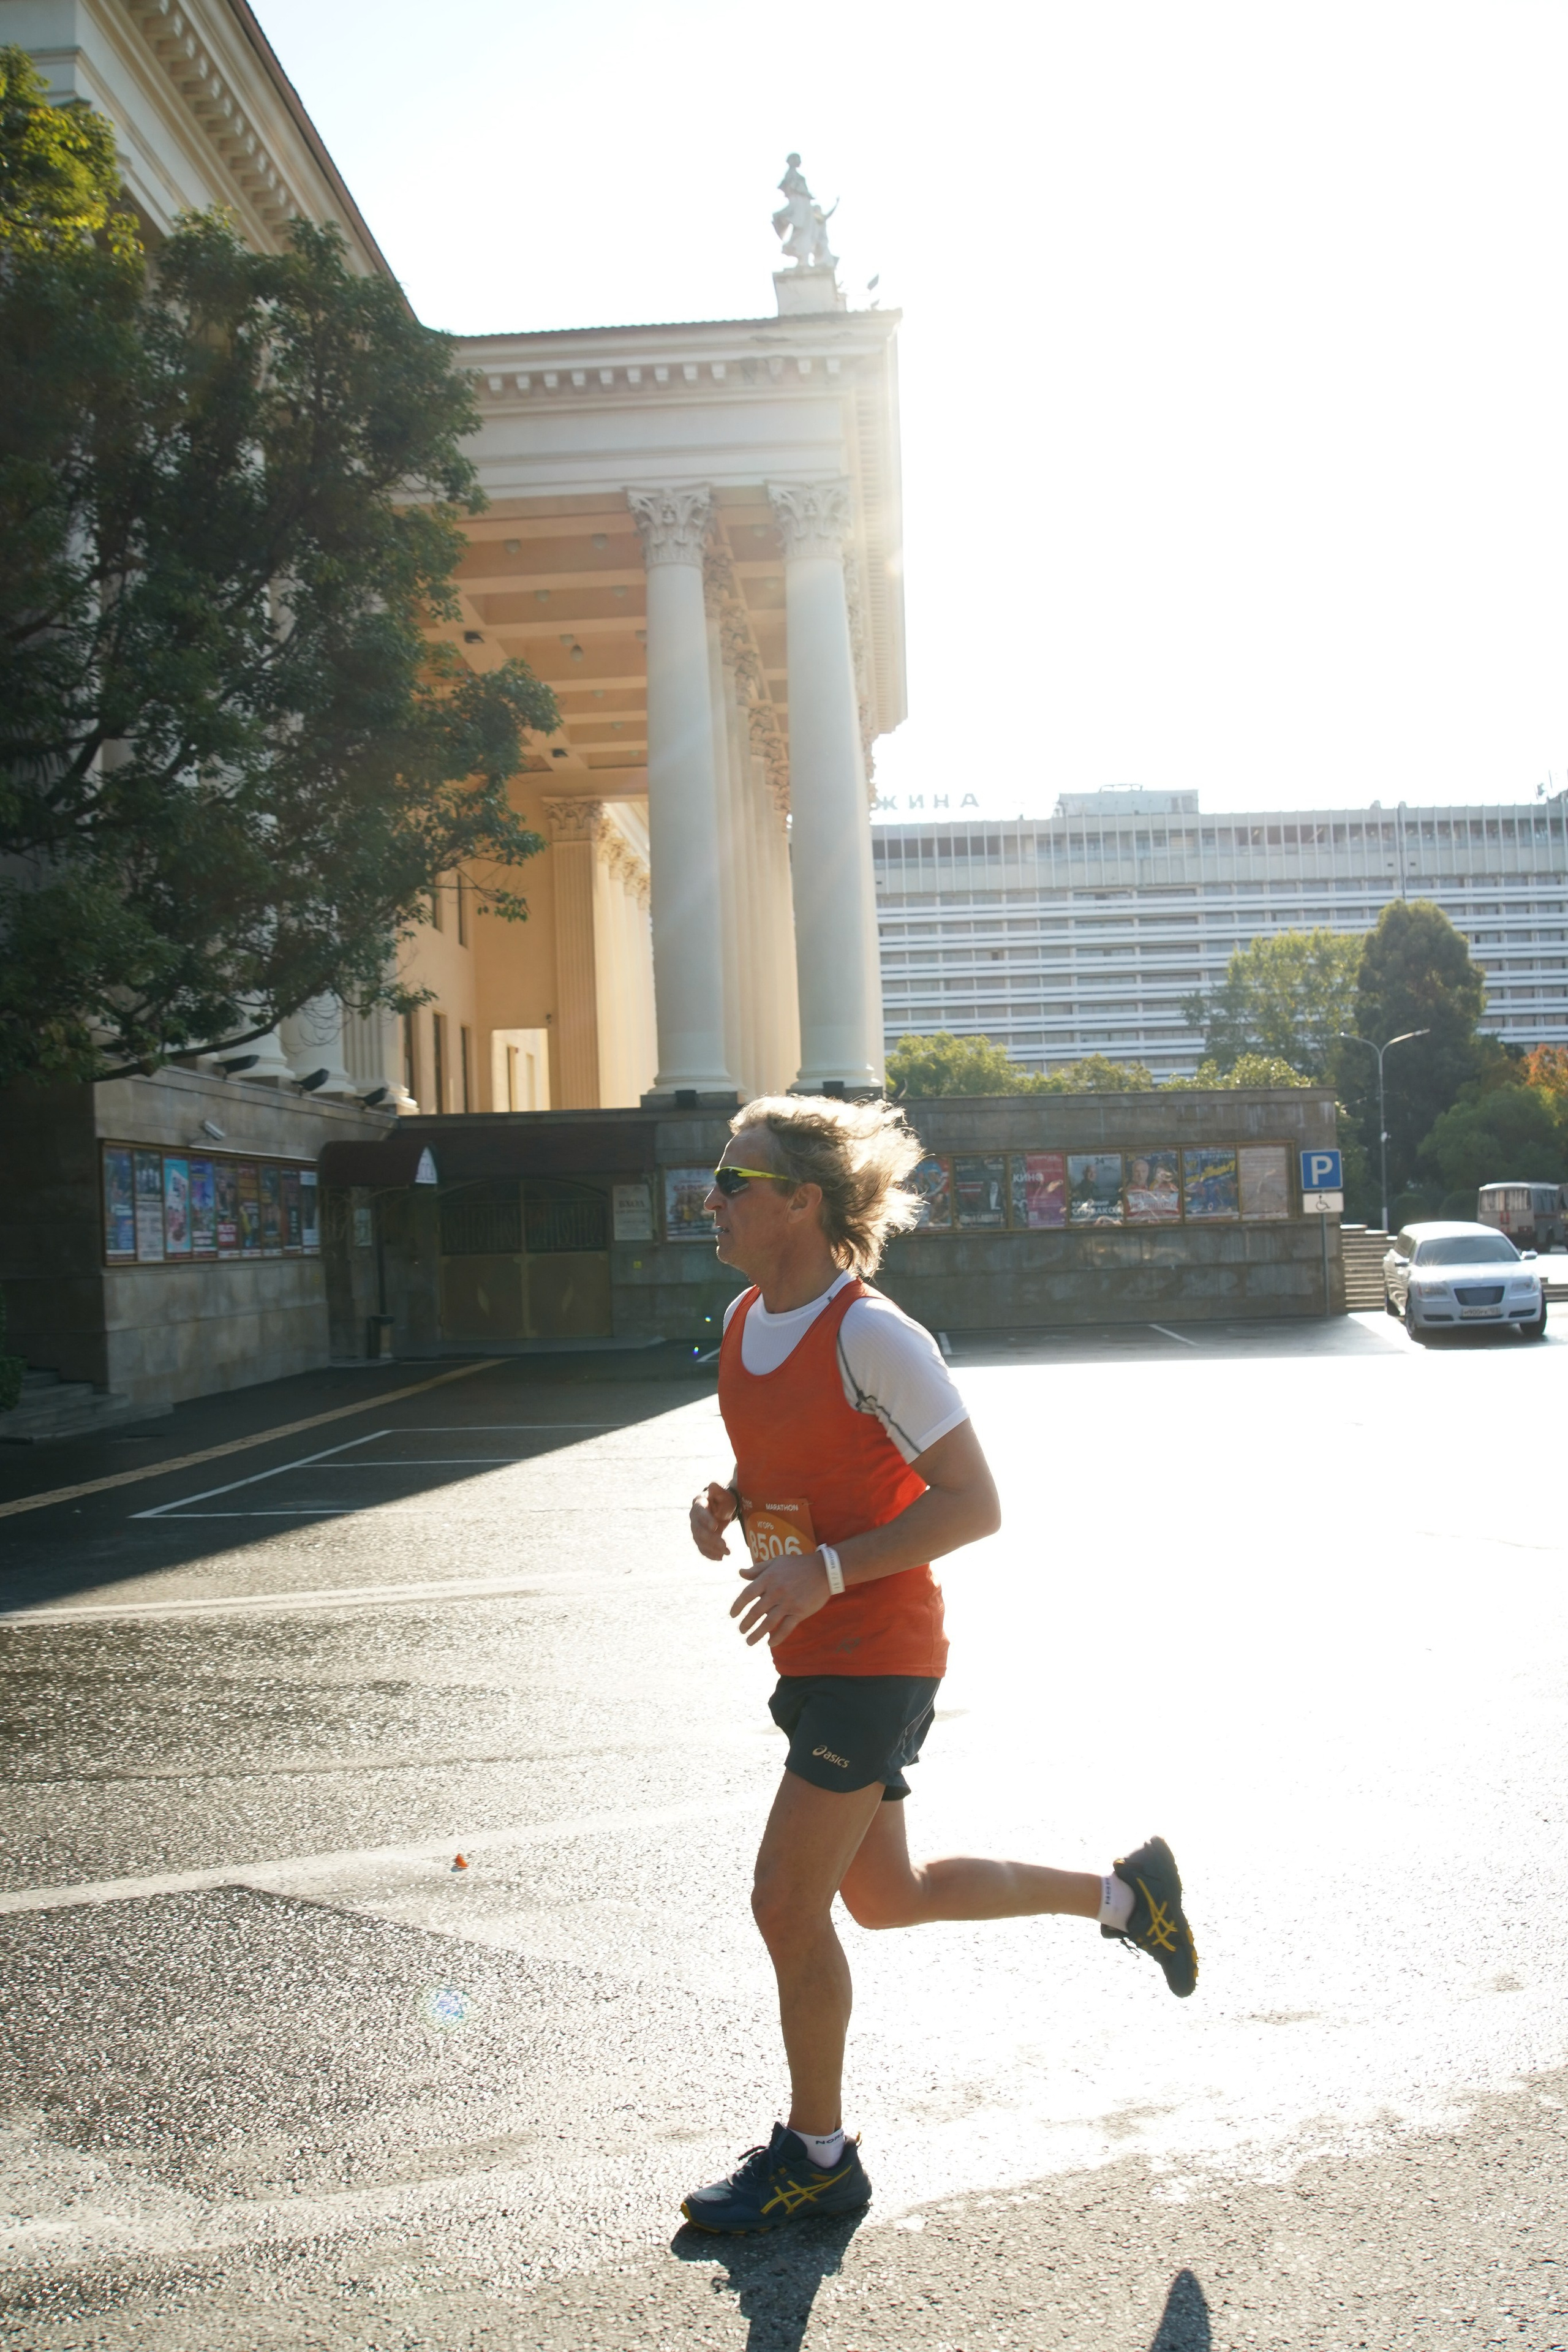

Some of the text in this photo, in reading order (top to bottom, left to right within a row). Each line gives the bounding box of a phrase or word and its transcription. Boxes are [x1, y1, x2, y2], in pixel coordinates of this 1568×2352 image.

[1311, 1155, 1333, 1186] P
[757, 1521, 774, 1529] ИГОРЬ
[749, 1530, 803, 1561] 8506
[823, 1751, 850, 1768] asics
